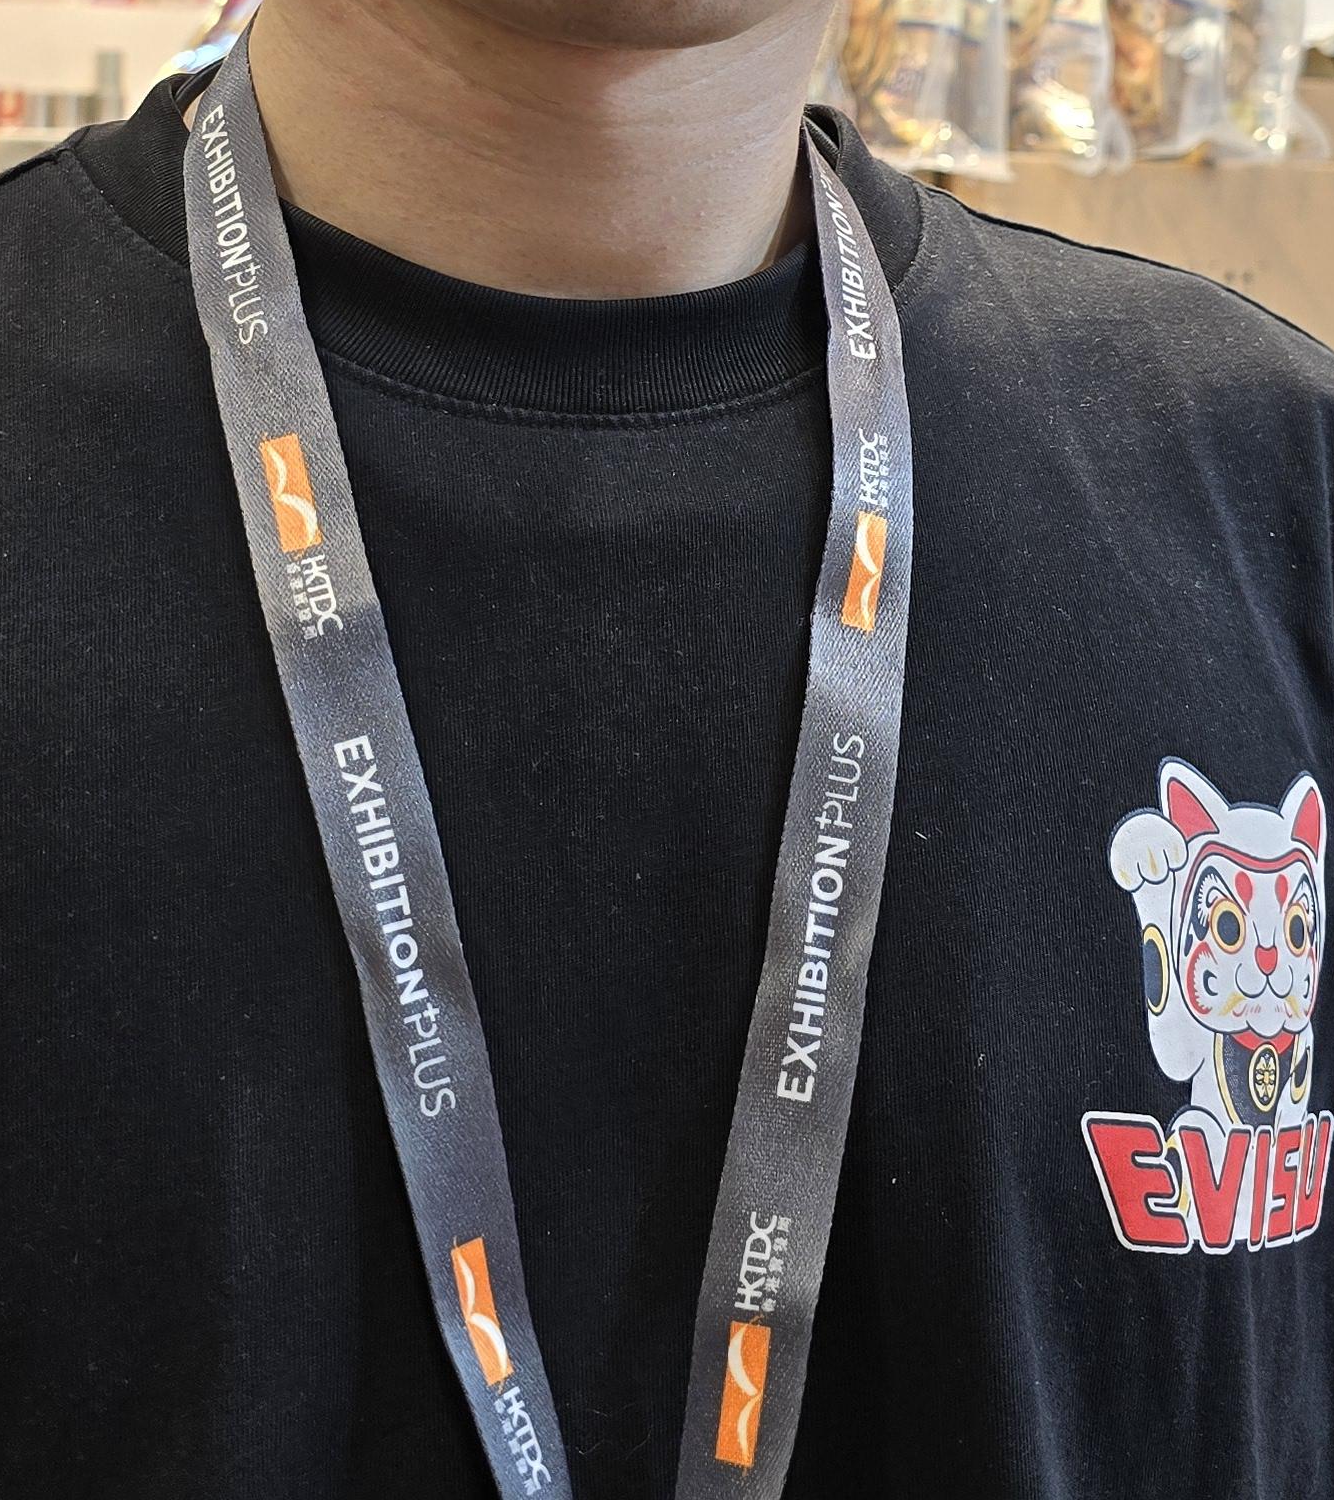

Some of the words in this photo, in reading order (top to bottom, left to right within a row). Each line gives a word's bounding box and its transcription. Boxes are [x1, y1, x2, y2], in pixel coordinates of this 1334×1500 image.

[858, 427, 880, 505] HKTDC
[301, 553, 344, 636] HKTDC
[1083, 1111, 1334, 1255] EVISU
[734, 1211, 778, 1312] HKTDC
[503, 1386, 552, 1490] HKTDC
